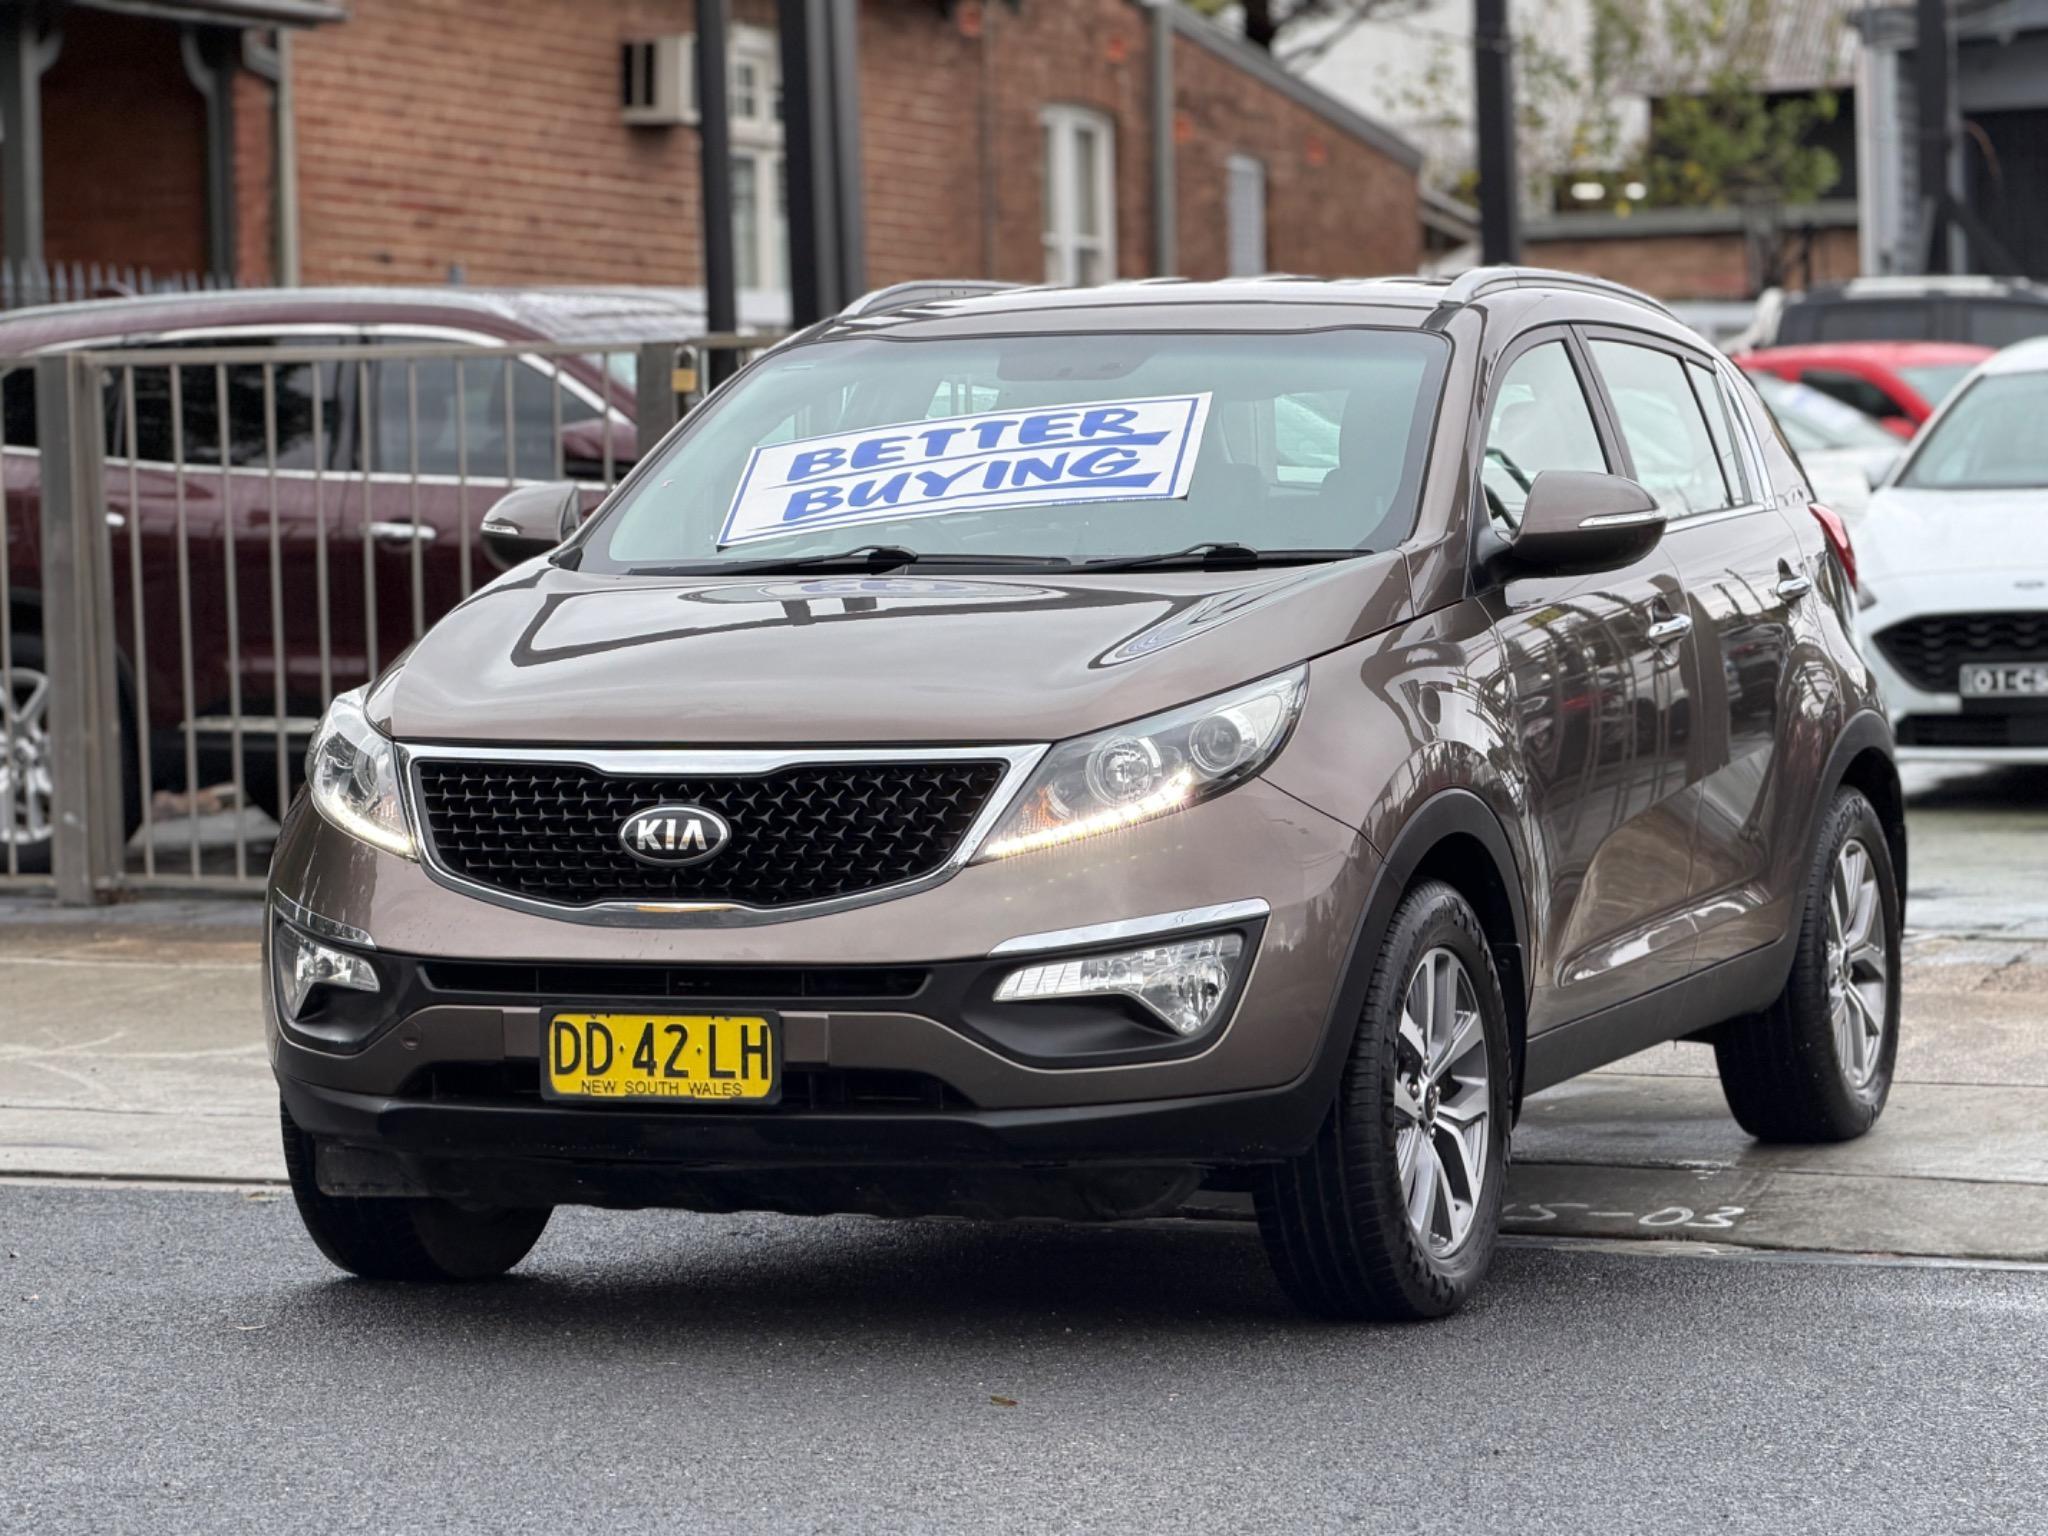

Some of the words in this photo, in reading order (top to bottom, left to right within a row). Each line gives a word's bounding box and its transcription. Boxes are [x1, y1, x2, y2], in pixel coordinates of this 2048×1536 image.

[786, 408, 1138, 482] BETTER
[781, 447, 1141, 521] BUYING
[637, 818, 708, 851] KIA
[580, 1079, 617, 1094] NEW
[624, 1080, 679, 1096] SOUTH
[688, 1081, 743, 1097] WALES
